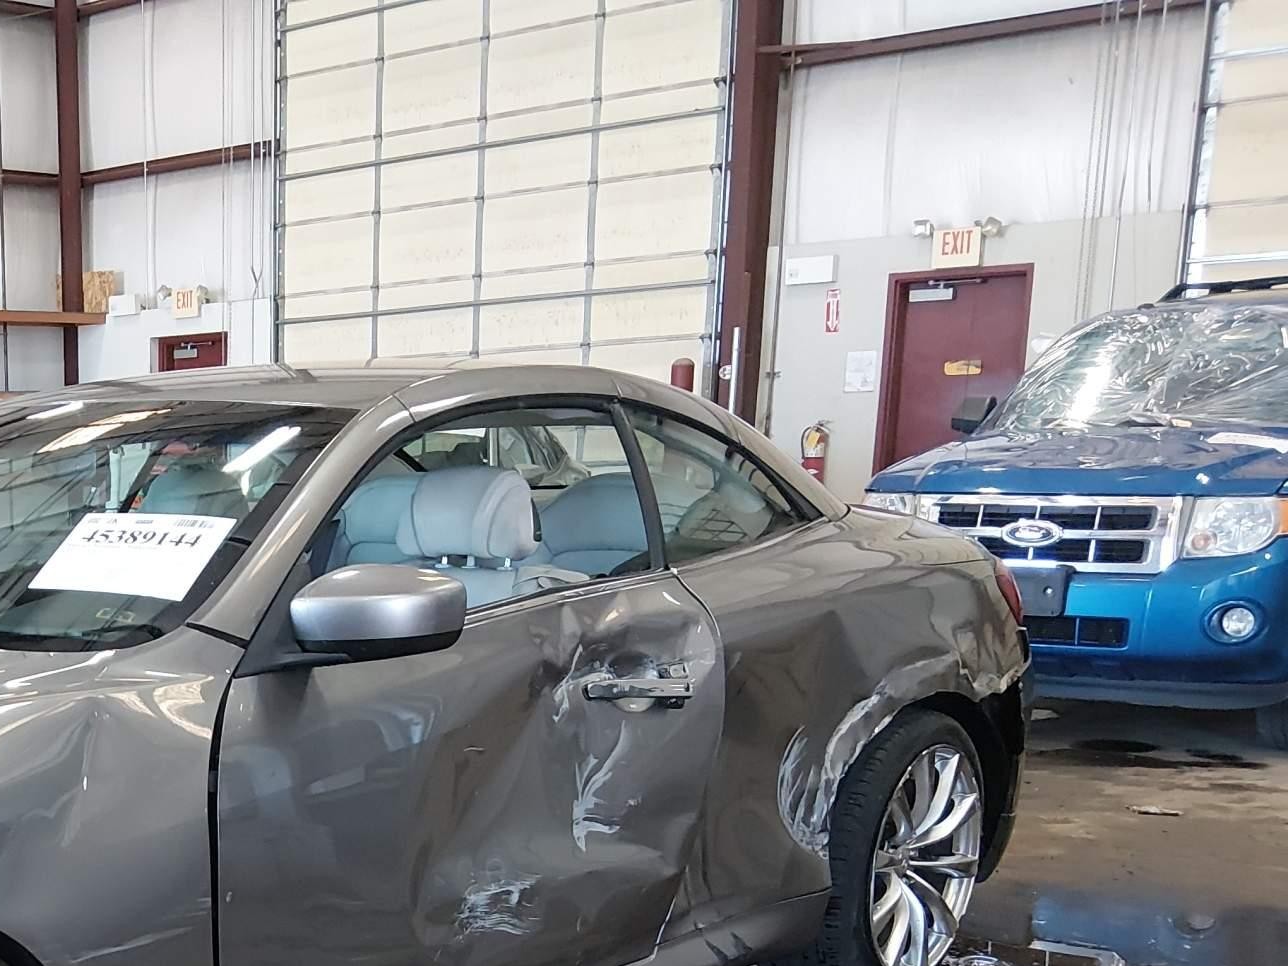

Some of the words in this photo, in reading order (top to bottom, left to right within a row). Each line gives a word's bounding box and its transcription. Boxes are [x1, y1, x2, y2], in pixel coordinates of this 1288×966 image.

[941, 230, 973, 255] EXIT
[176, 290, 193, 309] EXIT
[81, 529, 202, 547] 45389144
